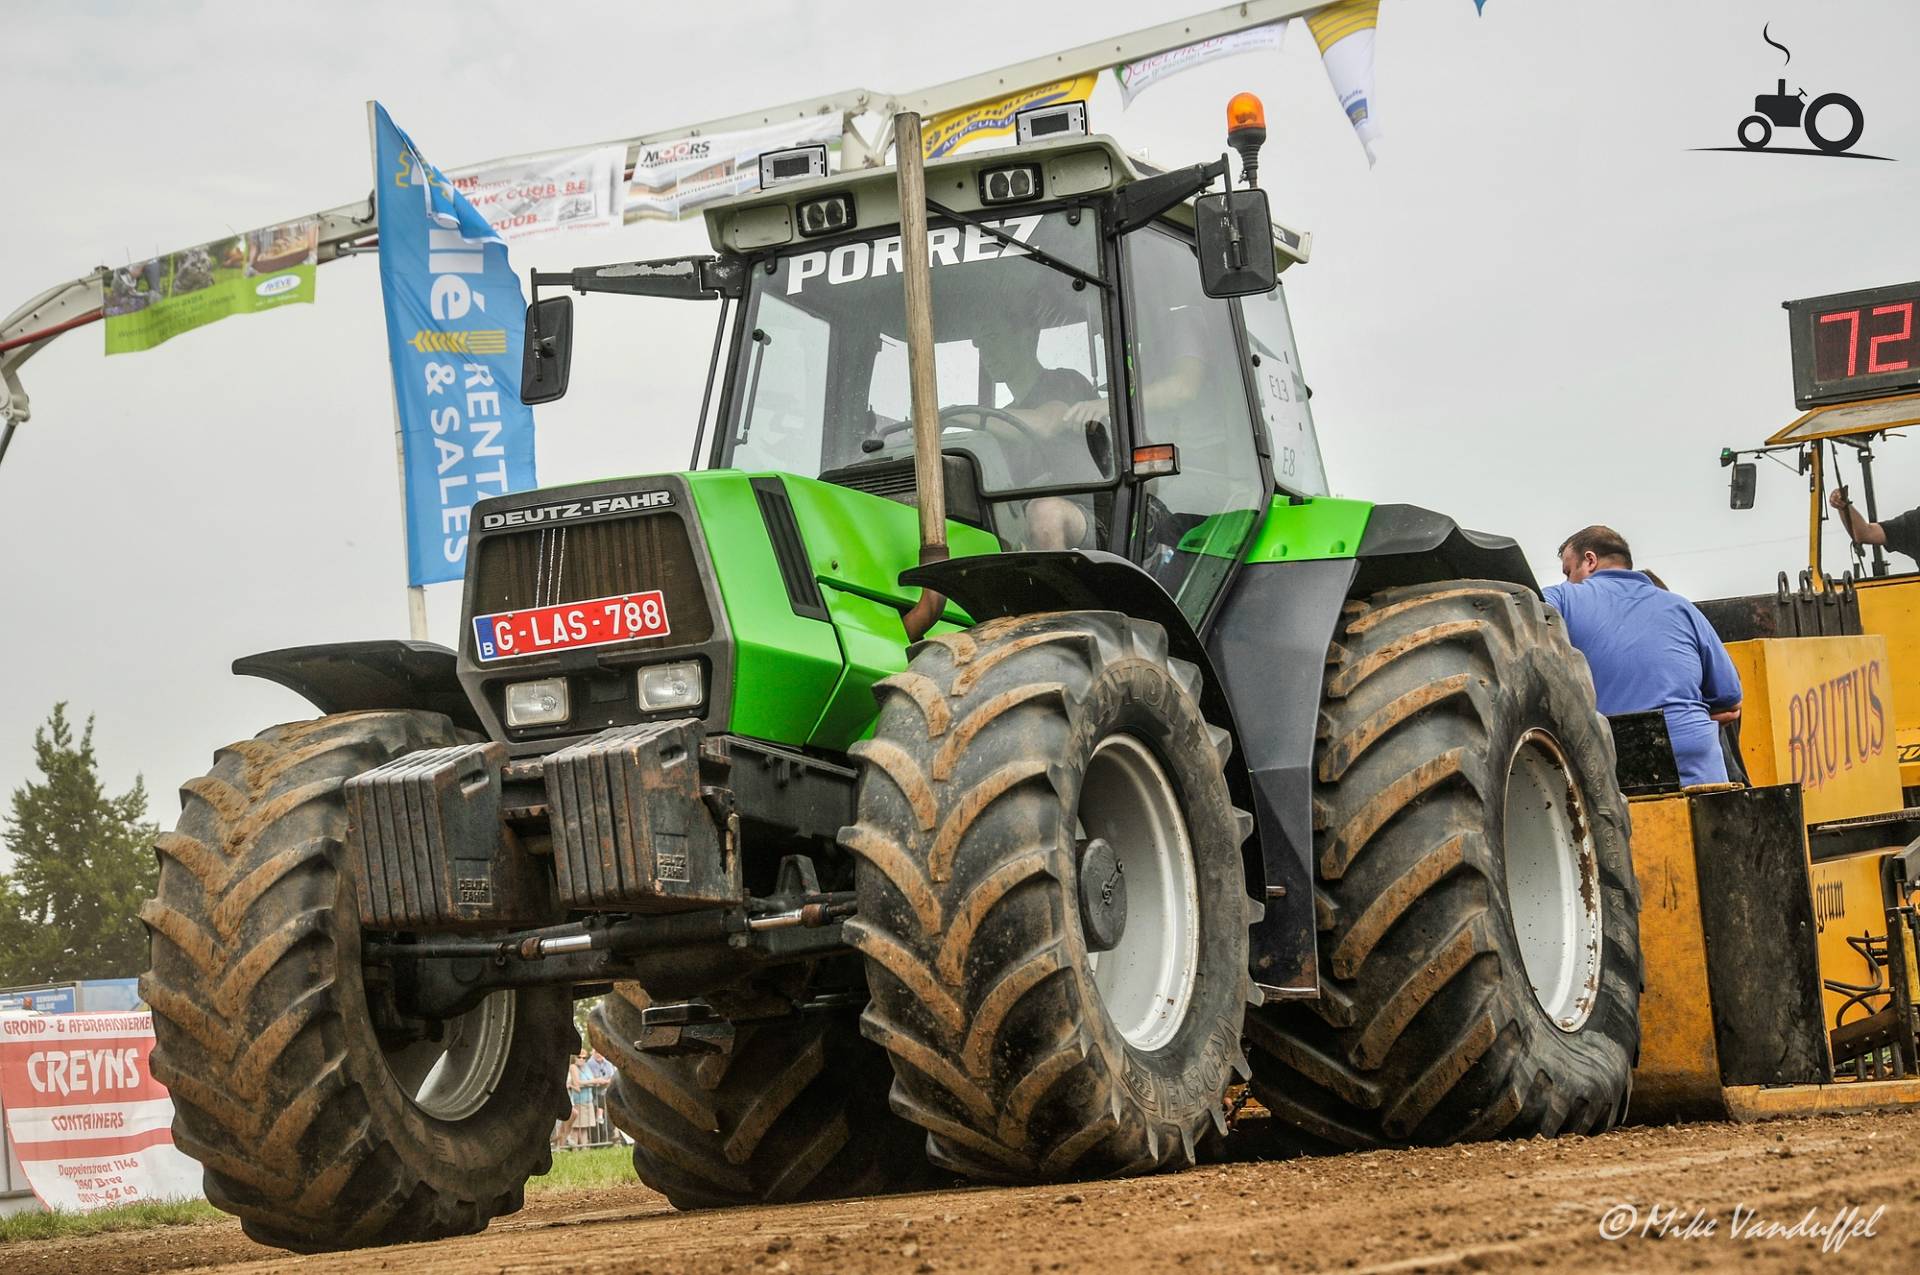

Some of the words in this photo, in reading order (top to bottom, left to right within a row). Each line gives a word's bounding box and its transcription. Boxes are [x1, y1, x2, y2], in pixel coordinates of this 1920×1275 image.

[944, 111, 981, 134] NEW
[984, 83, 1061, 117] HOLLAND
[644, 141, 711, 162] MOORS
[942, 113, 1019, 151] AGRICULTU
[786, 214, 1044, 295] PORREZ
[1819, 302, 1913, 377] 72
[425, 362, 455, 395] &
[463, 364, 509, 501] RENT
[1282, 446, 1296, 478] E8
[430, 408, 470, 564] SALES
[483, 490, 671, 529] DEUTZ-FAHR
[494, 599, 662, 651] G-LAS-788
[482, 641, 495, 656] B
[1788, 659, 1885, 792] BRUTUS
[1815, 871, 1846, 934] gium
[3, 1019, 47, 1036] GROND
[69, 1016, 153, 1034] AFBRAAKWERKE
[26, 1047, 140, 1097] CREYNS
[51, 1111, 124, 1132] CONTAINERS
[95, 1175, 123, 1188] Bree
